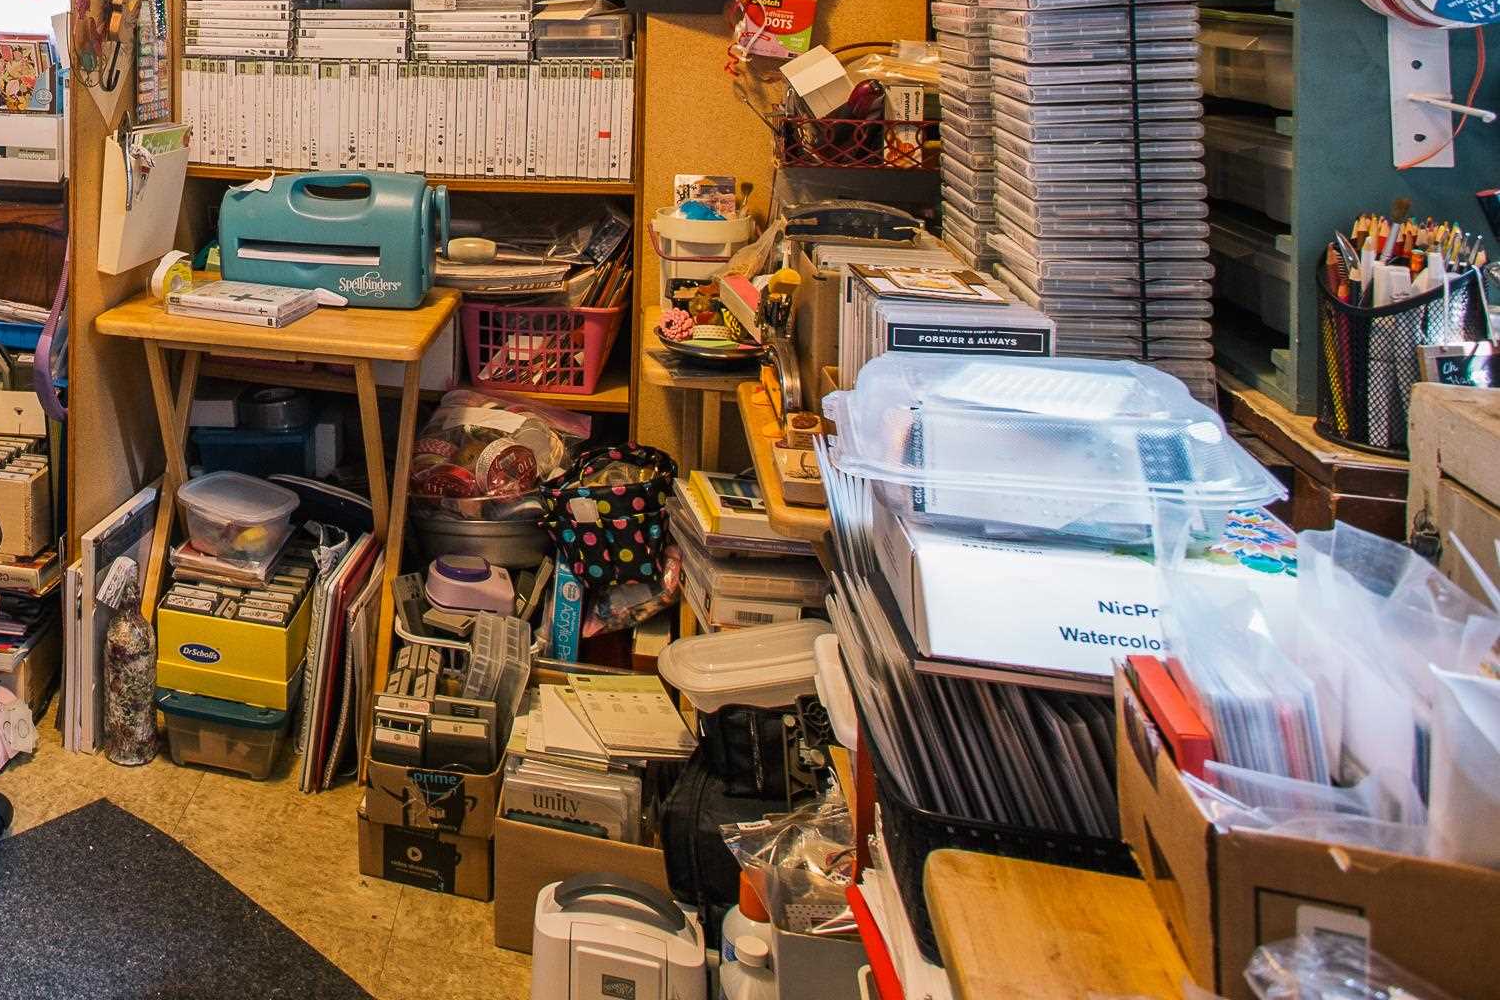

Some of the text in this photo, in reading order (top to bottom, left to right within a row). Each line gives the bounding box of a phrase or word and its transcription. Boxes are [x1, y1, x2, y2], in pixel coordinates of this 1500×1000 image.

[764, 18, 794, 30] DOTS
[339, 274, 400, 295] Spellbinders
[918, 335, 1018, 346] FOREVER & ALWAYS
[1098, 600, 1160, 618] NicPr
[561, 602, 571, 645] Acrylic
[413, 772, 458, 785] prime
[532, 790, 581, 817] unity
